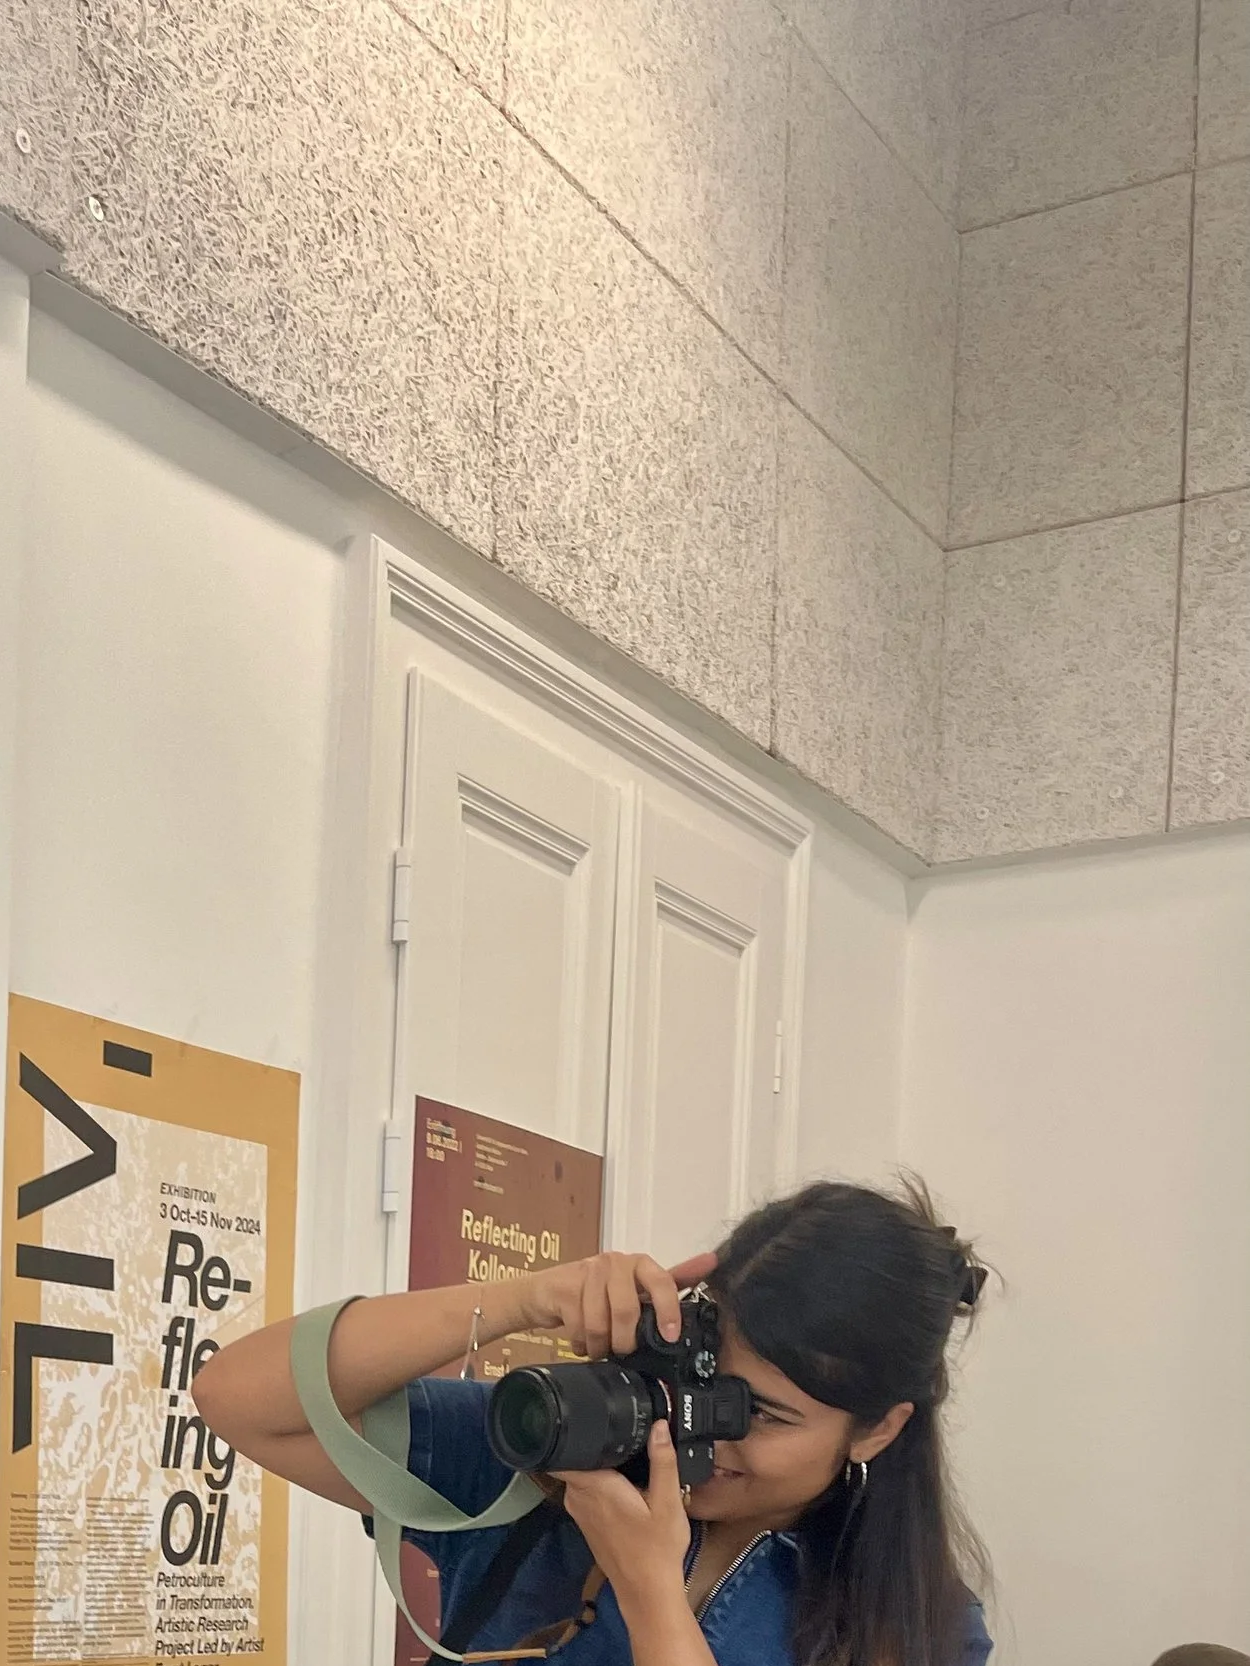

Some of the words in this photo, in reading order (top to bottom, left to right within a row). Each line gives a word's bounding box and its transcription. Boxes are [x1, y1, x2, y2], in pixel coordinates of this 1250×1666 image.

[159, 1182, 217, 1205] EXHIBITION
[159, 1203, 168, 1219] 3
[210, 1211, 233, 1232] Nov
[235, 1217, 262, 1236] 2024
[461, 1208, 536, 1263] Reflecting
[540, 1230, 560, 1262] Oil
[161, 1229, 252, 1311] Re-
[683, 1394, 693, 1431] SONY
[161, 1395, 236, 1491] ing
[160, 1490, 229, 1566] Oil
[156, 1571, 225, 1588] Petroculture
[156, 1593, 166, 1610] in
[155, 1616, 195, 1633] Artistic
[197, 1615, 249, 1632] Research
[155, 1639, 195, 1658] Project
[197, 1638, 218, 1654] Led
[220, 1638, 234, 1656] by
[235, 1637, 265, 1653] Artist
